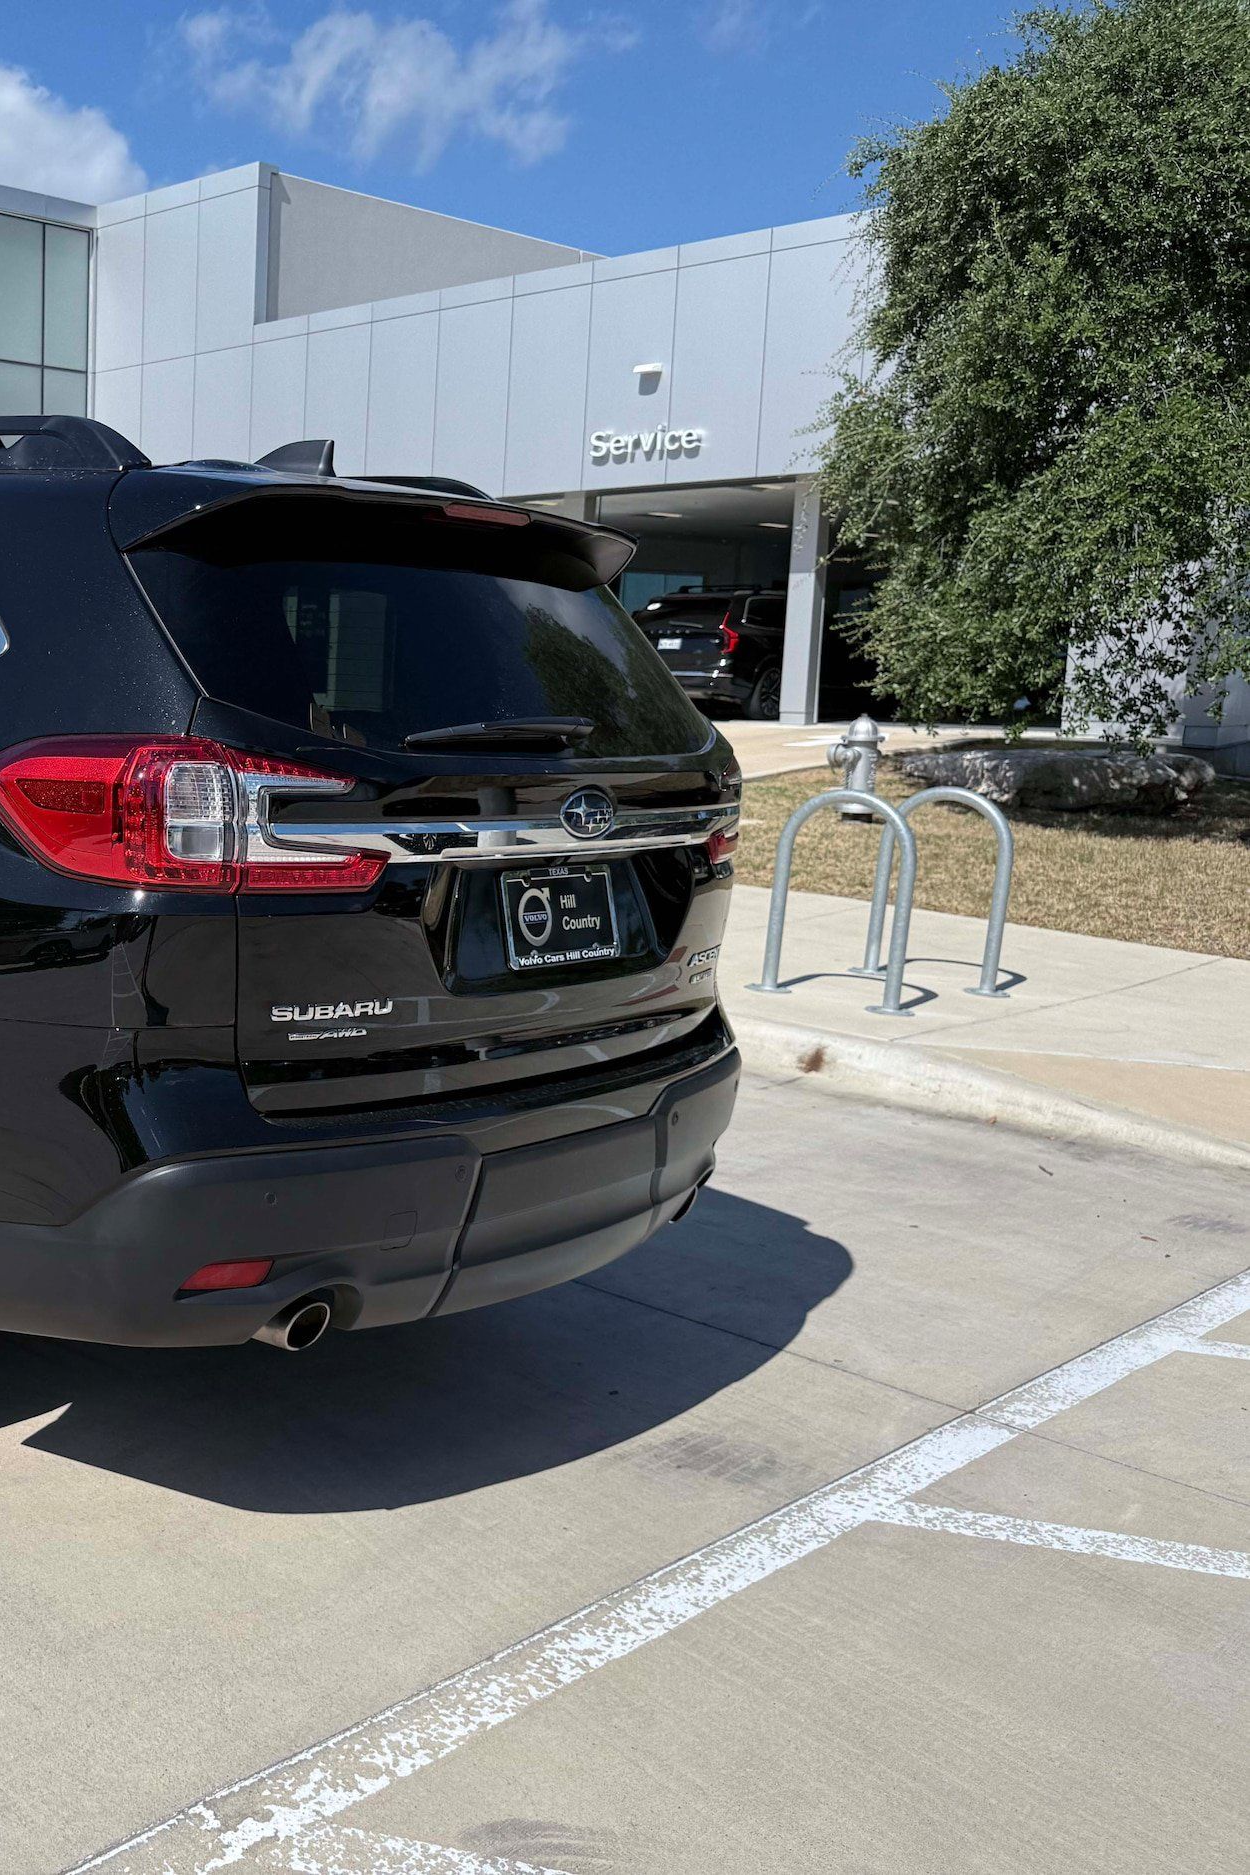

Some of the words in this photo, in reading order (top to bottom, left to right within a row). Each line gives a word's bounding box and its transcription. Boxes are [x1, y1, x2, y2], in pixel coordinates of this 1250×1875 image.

[589, 425, 702, 458] Service
[548, 867, 569, 876] TEXAS
[560, 893, 576, 909] Hill
[523, 913, 548, 922] VOLVO
[562, 914, 601, 931] Country
[518, 955, 543, 967] Volvo
[544, 952, 565, 963] Cars
[566, 950, 581, 960] Hill
[581, 947, 615, 959] Country
[270, 998, 394, 1022] SUBARU
[318, 1027, 368, 1040] AWD
